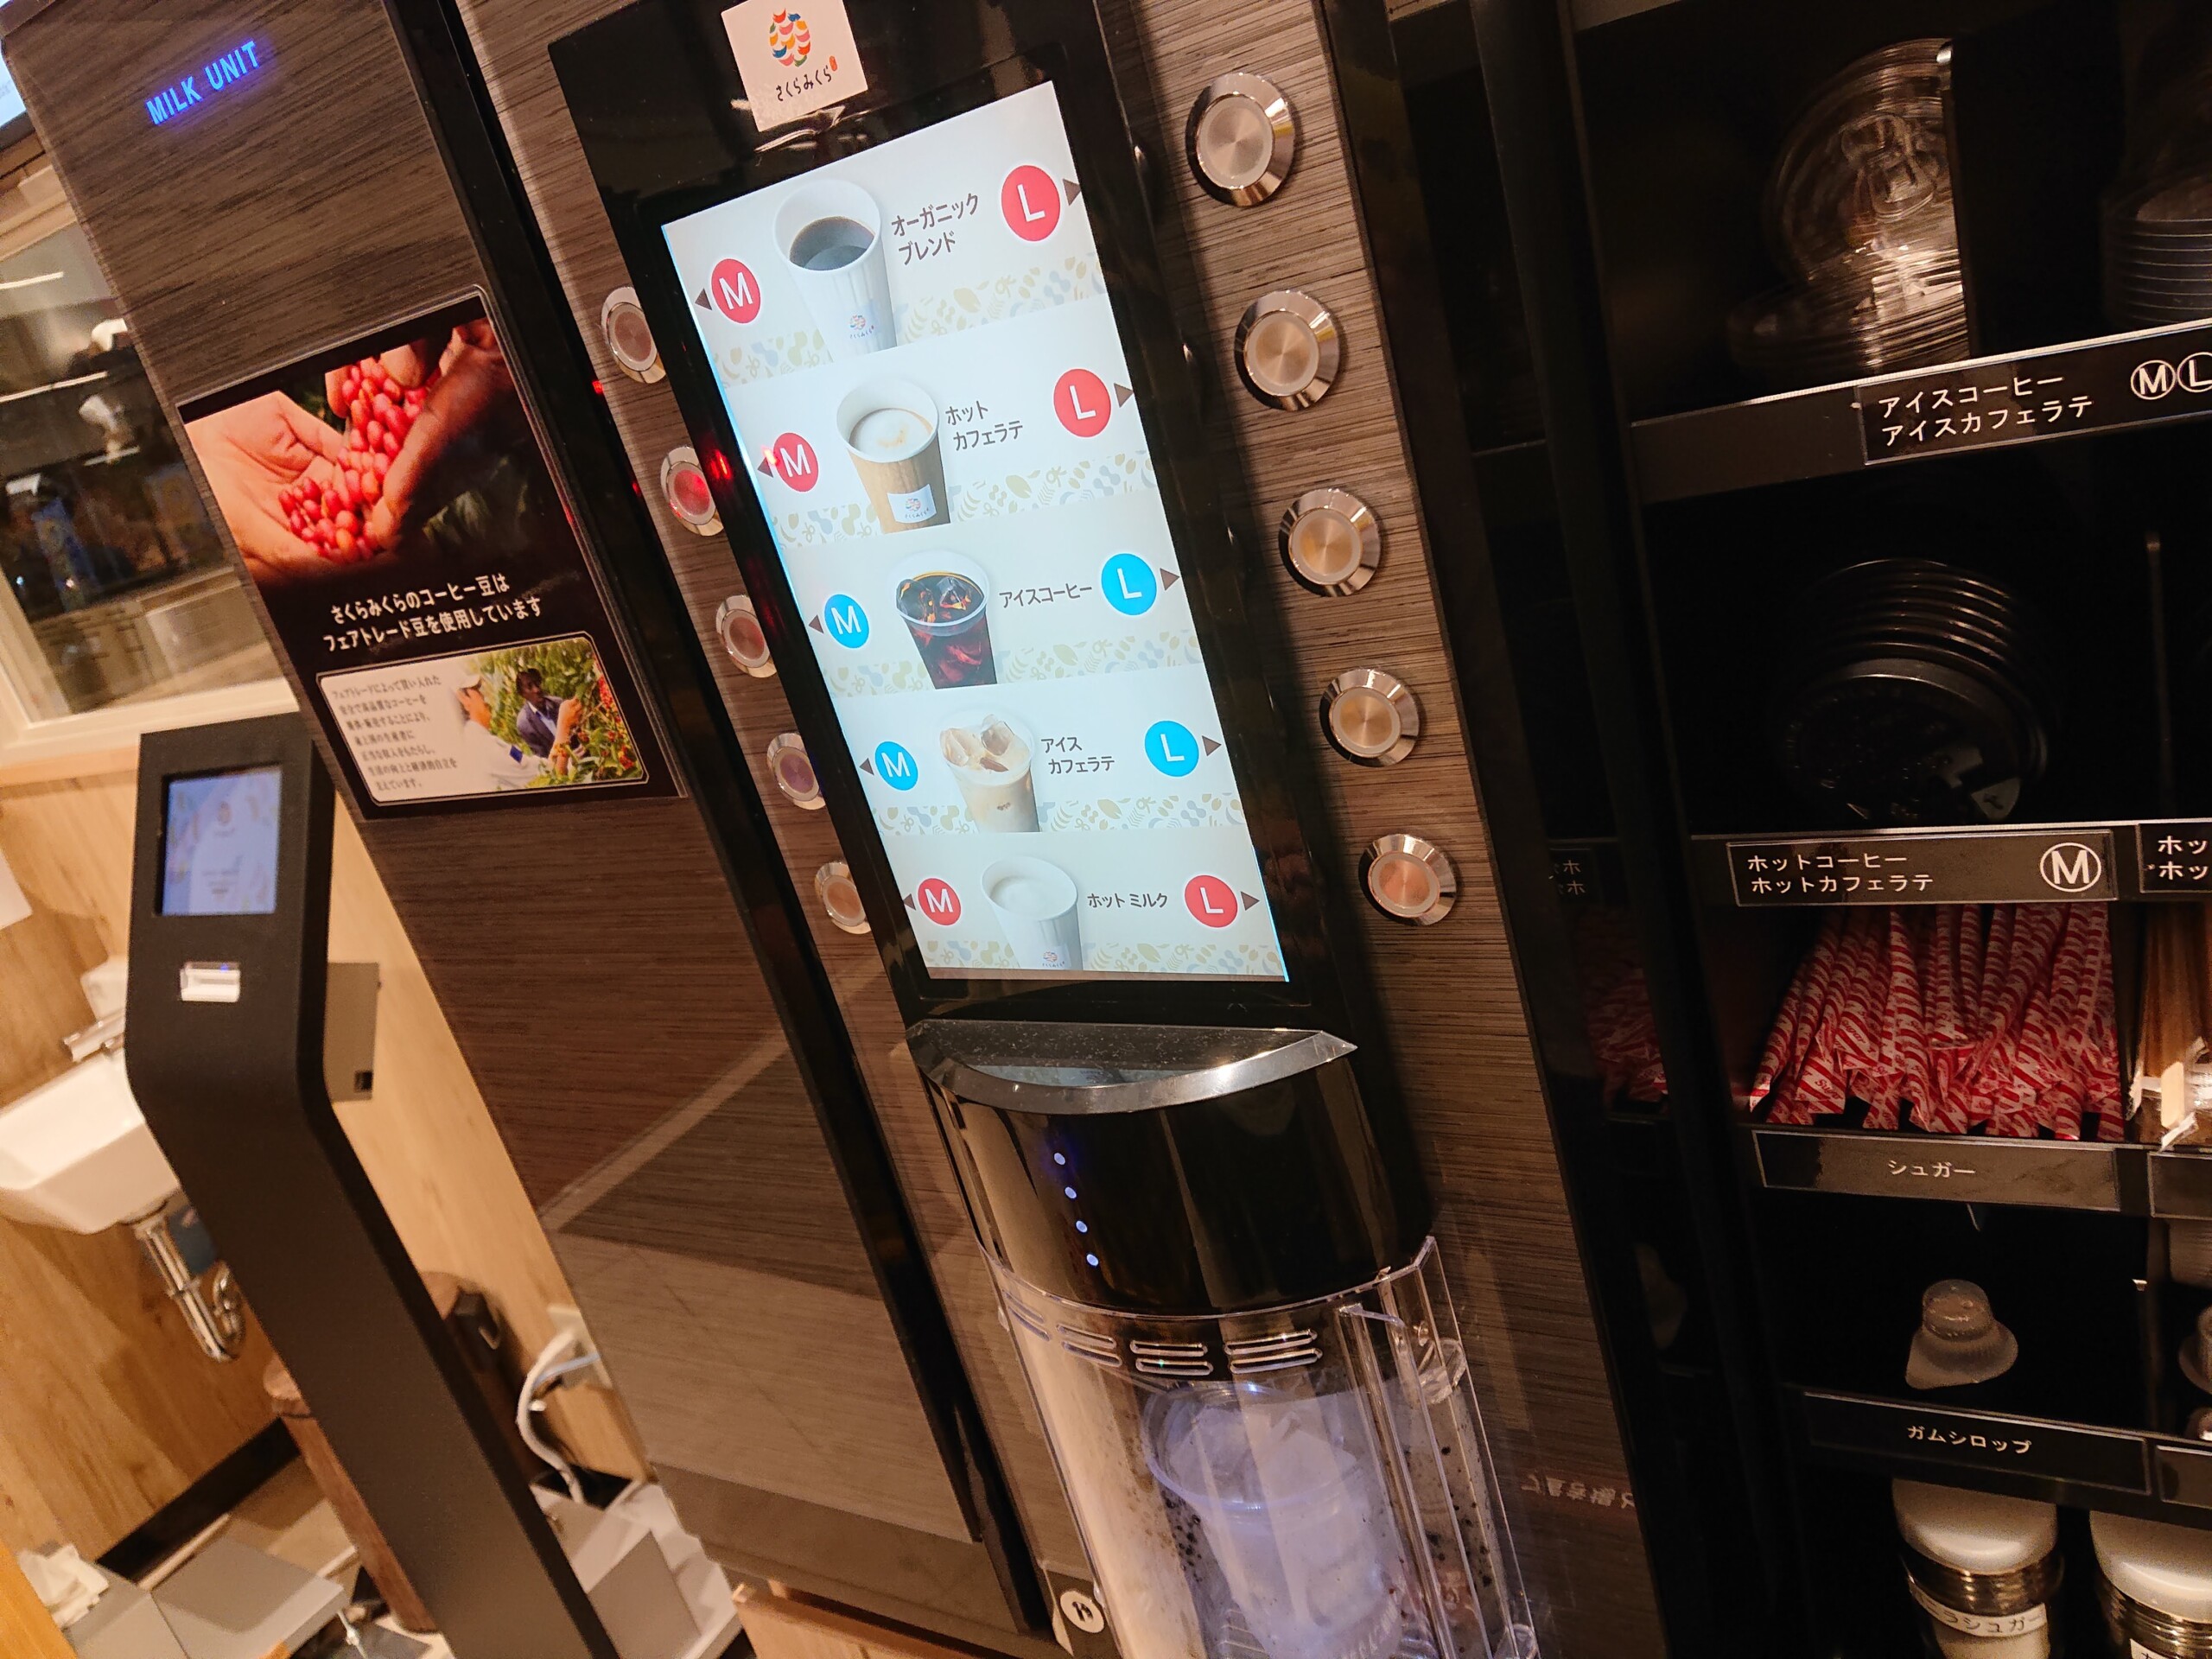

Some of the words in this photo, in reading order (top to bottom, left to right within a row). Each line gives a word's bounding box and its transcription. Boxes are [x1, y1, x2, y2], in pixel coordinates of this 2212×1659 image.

[145, 75, 202, 125] MILK
[204, 40, 258, 91] UNIT
[775, 65, 832, 102] さくらみくら
[891, 192, 979, 237] オーガニック
[1016, 183, 1046, 223] L
[898, 230, 956, 266] ブレンド
[718, 270, 753, 310] M
[944, 400, 988, 426] ホット
[1069, 385, 1096, 421] L
[1878, 376, 2065, 419] アイスコーヒー
[952, 420, 1024, 452] カフェラテ
[1881, 395, 2093, 447] アイスカフェラテ
[779, 443, 811, 478] M
[330, 573, 511, 625] さくらみくらのコーヒー豆は
[998, 582, 1093, 609] アイスコーヒー
[1116, 567, 1143, 600] L
[322, 595, 542, 652] フェアトレード豆を使用しています
[830, 604, 862, 636] M
[1040, 736, 1083, 754] アイス
[1160, 734, 1185, 762] L
[880, 751, 911, 778] M
[1048, 755, 1116, 775] カフェラテ
[2158, 835, 2208, 855] ホッ
[1747, 853, 1908, 873] ホットコーヒー
[2158, 861, 2209, 880] ホッ
[1751, 874, 1934, 894] ホットカフェラテ
[924, 888, 954, 913] M
[1199, 887, 1224, 914] L
[1887, 1160, 1976, 1178] シュガー
[1907, 1425, 2032, 1454] ガムシロップ
